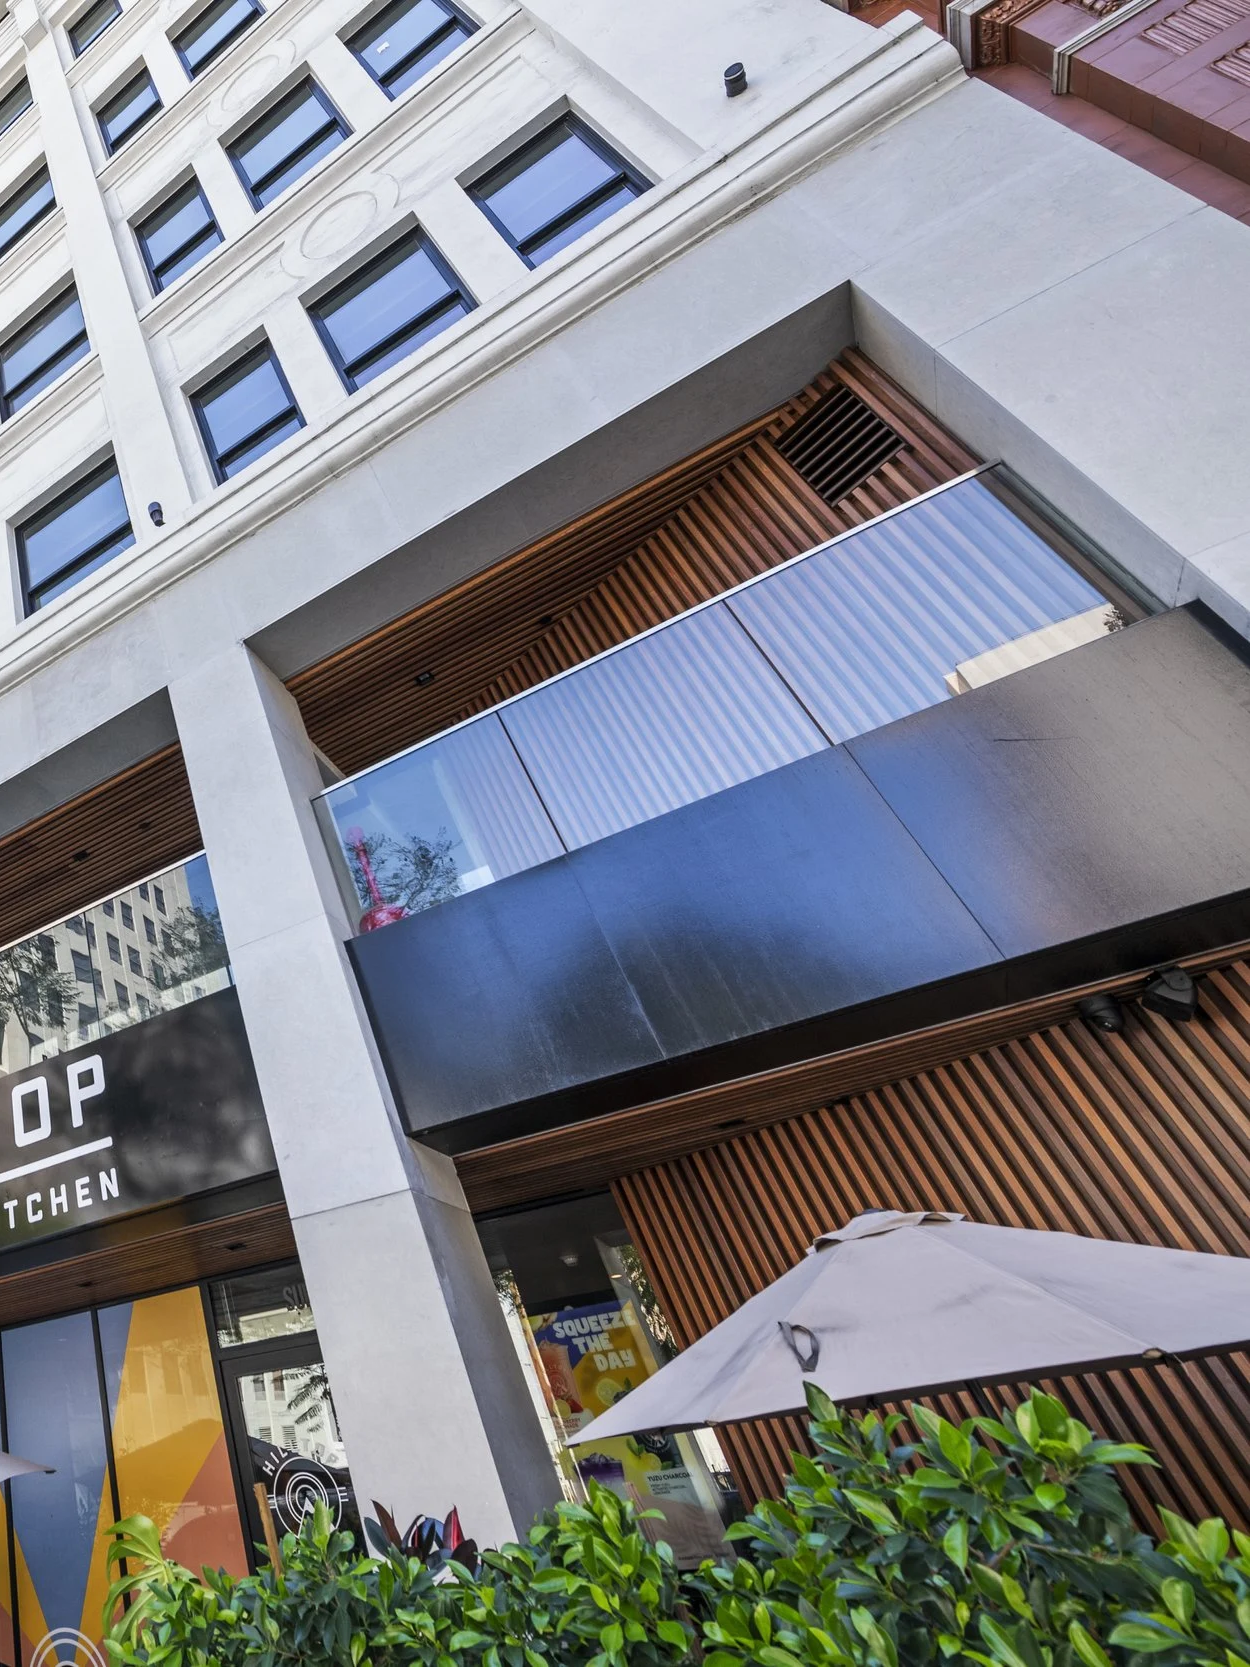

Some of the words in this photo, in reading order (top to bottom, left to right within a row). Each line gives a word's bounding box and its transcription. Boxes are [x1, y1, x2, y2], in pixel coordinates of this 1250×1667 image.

[552, 1309, 636, 1339] SQUEEZE
[572, 1332, 614, 1355] THE
[593, 1348, 637, 1372] DAY
[647, 1474, 663, 1482] YUZU
